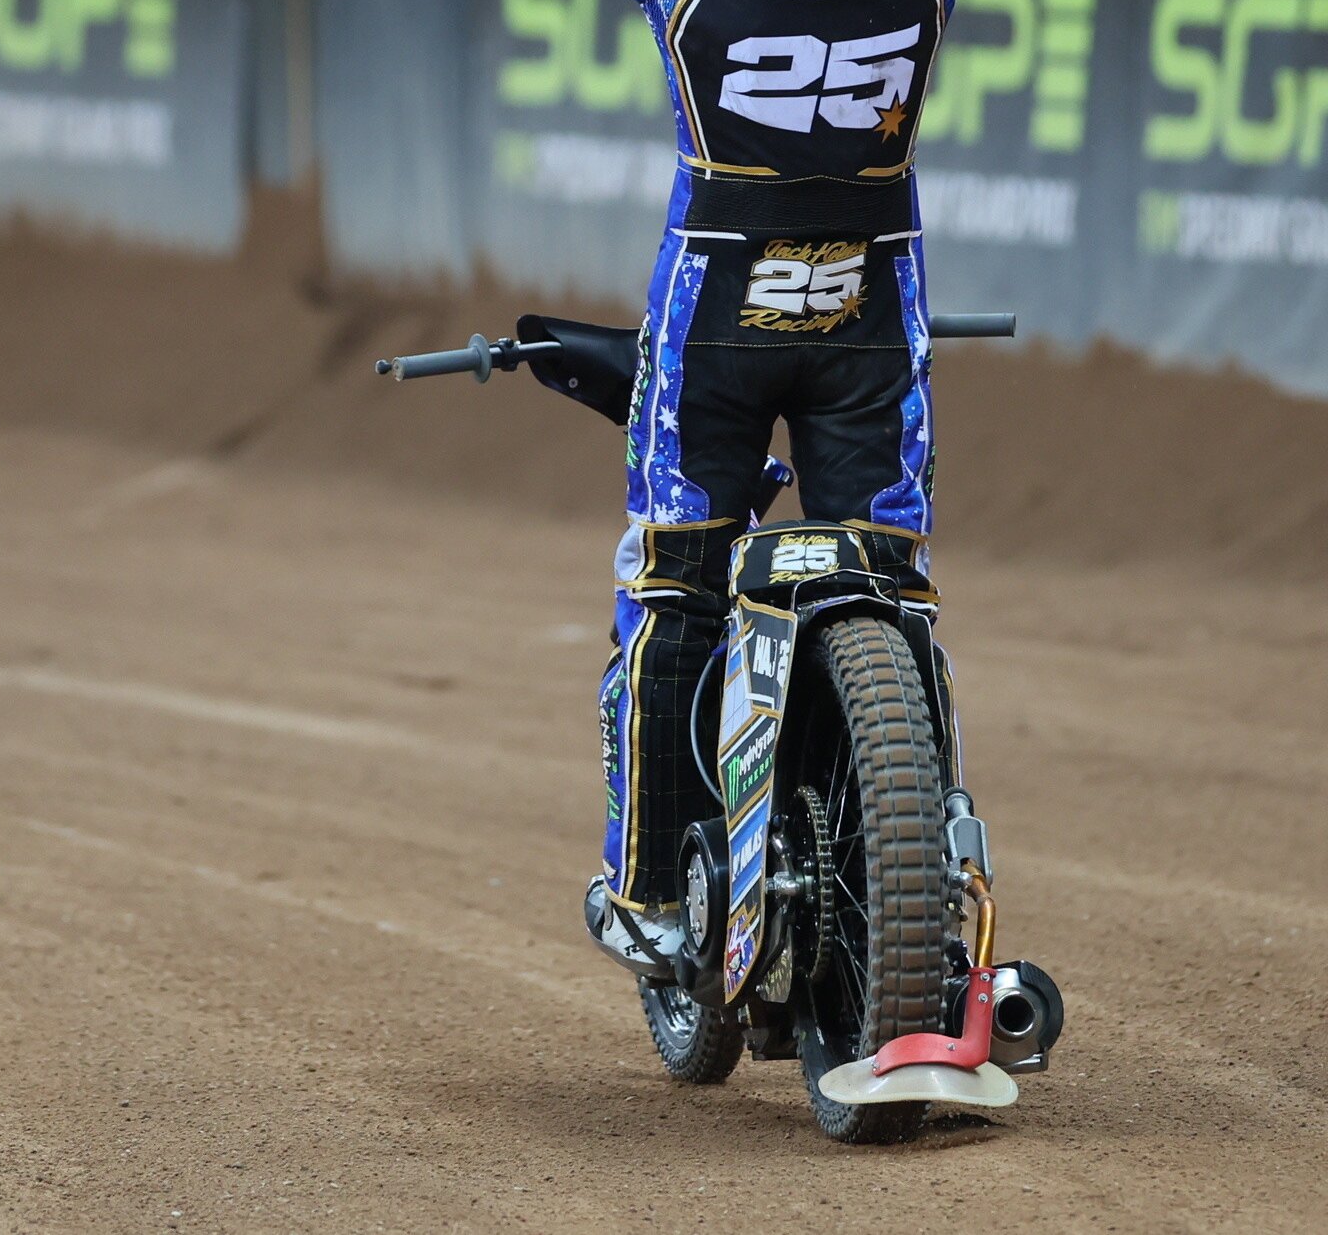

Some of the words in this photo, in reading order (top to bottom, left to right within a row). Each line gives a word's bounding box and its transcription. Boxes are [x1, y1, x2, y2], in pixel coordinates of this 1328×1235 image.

[718, 22, 921, 134] 25
[744, 250, 867, 316] 25
[771, 543, 839, 574] 25
[739, 720, 777, 776] MONSTER
